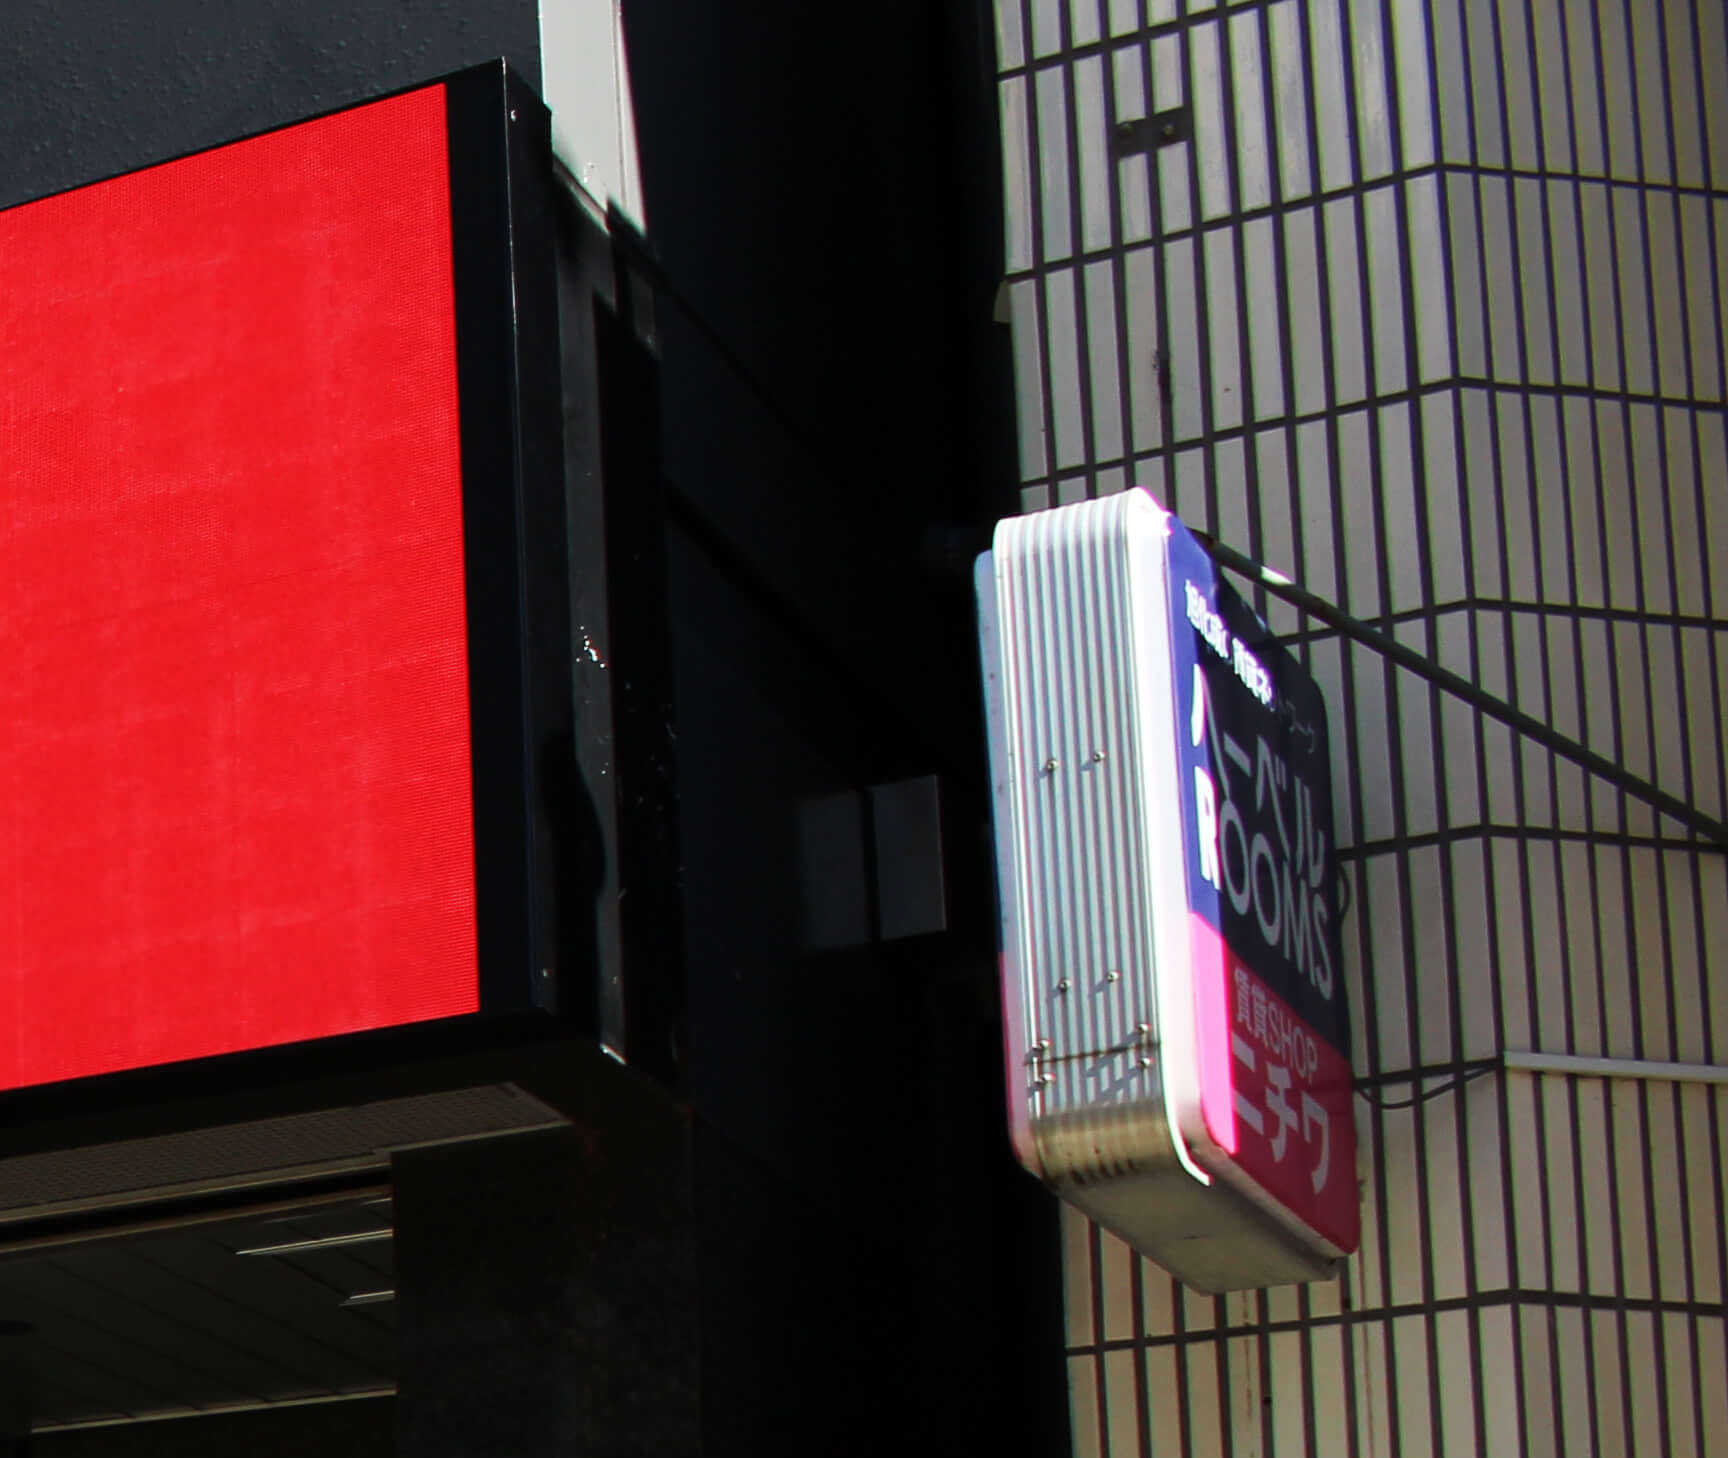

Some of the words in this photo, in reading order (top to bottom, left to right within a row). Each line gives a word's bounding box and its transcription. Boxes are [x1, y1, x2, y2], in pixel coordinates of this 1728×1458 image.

[1194, 764, 1333, 999] ROOMS
[1232, 1032, 1331, 1195] ニチワ
